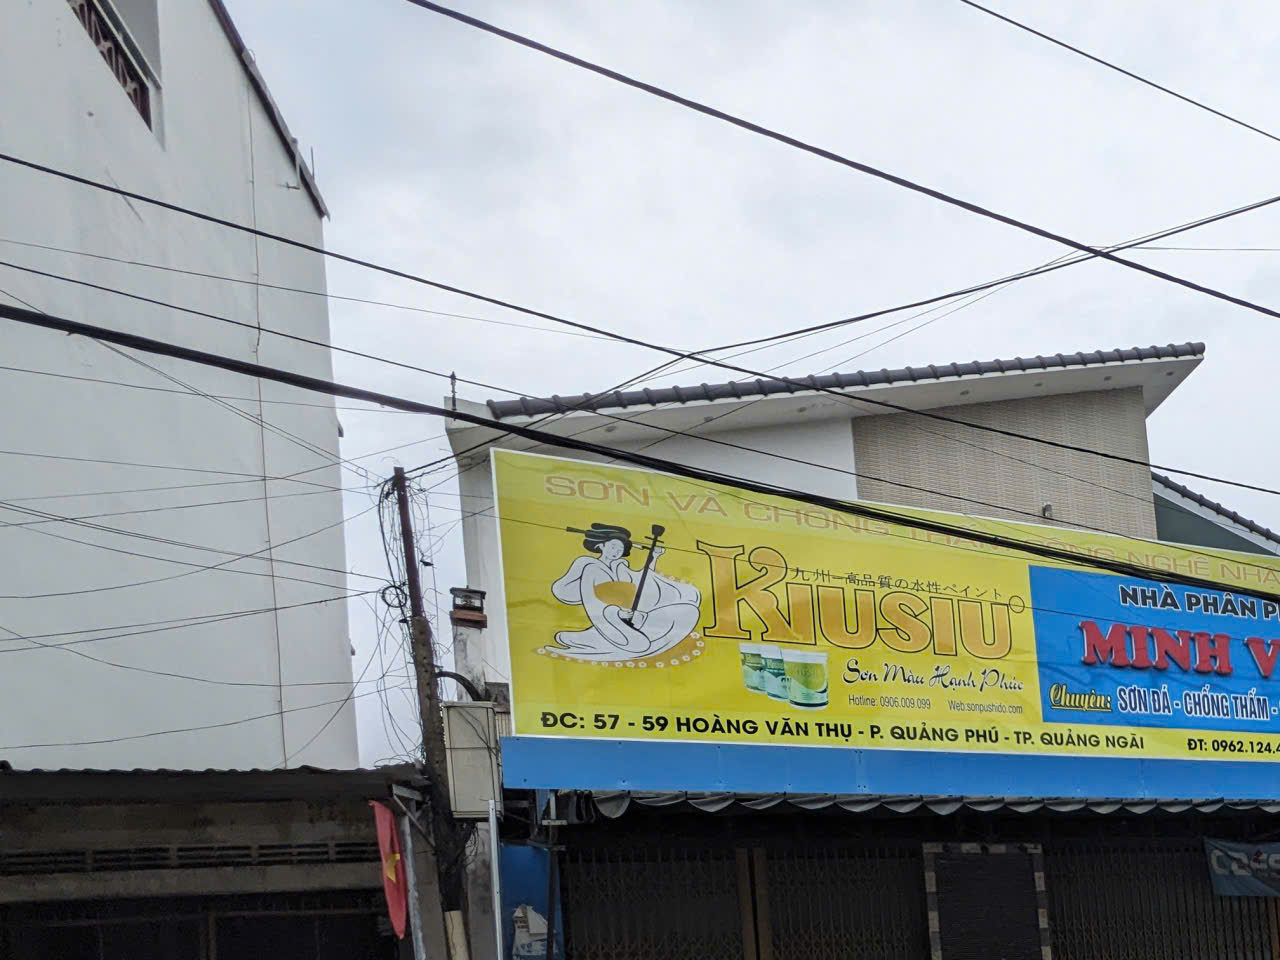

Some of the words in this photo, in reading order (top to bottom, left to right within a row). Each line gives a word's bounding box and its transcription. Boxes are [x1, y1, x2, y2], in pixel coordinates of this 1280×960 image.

[544, 475, 648, 507] SƠN
[666, 491, 728, 517] VÀ
[1118, 583, 1180, 612] NHÀ
[1185, 591, 1257, 619] PHÂN
[1079, 620, 1234, 675] MINH
[842, 658, 878, 684] Sơn
[883, 663, 925, 685] Màu
[928, 665, 977, 691] Hạnh
[979, 668, 1025, 692] Phúc
[848, 694, 878, 707] Hotline:
[879, 696, 931, 709] 0906.009.099
[1116, 686, 1149, 712] SƠN
[1149, 684, 1172, 715] ĐÁ
[1183, 685, 1230, 718] CHỐNG
[1230, 687, 1269, 721] THẤM
[541, 711, 586, 729] ĐC:
[593, 713, 620, 730] 57
[642, 715, 669, 732] 59
[676, 714, 759, 735] HOÀNG
[765, 717, 809, 737] VĂN
[815, 722, 853, 742] THỤ
[870, 725, 884, 740] P.
[890, 722, 959, 742] QUẢNG
[965, 726, 999, 744] PHÚ
[1014, 731, 1035, 746] TP.
[1040, 728, 1101, 748] QUẢNG
[1105, 733, 1146, 750] NGÃI
[1187, 738, 1208, 752] ĐT:
